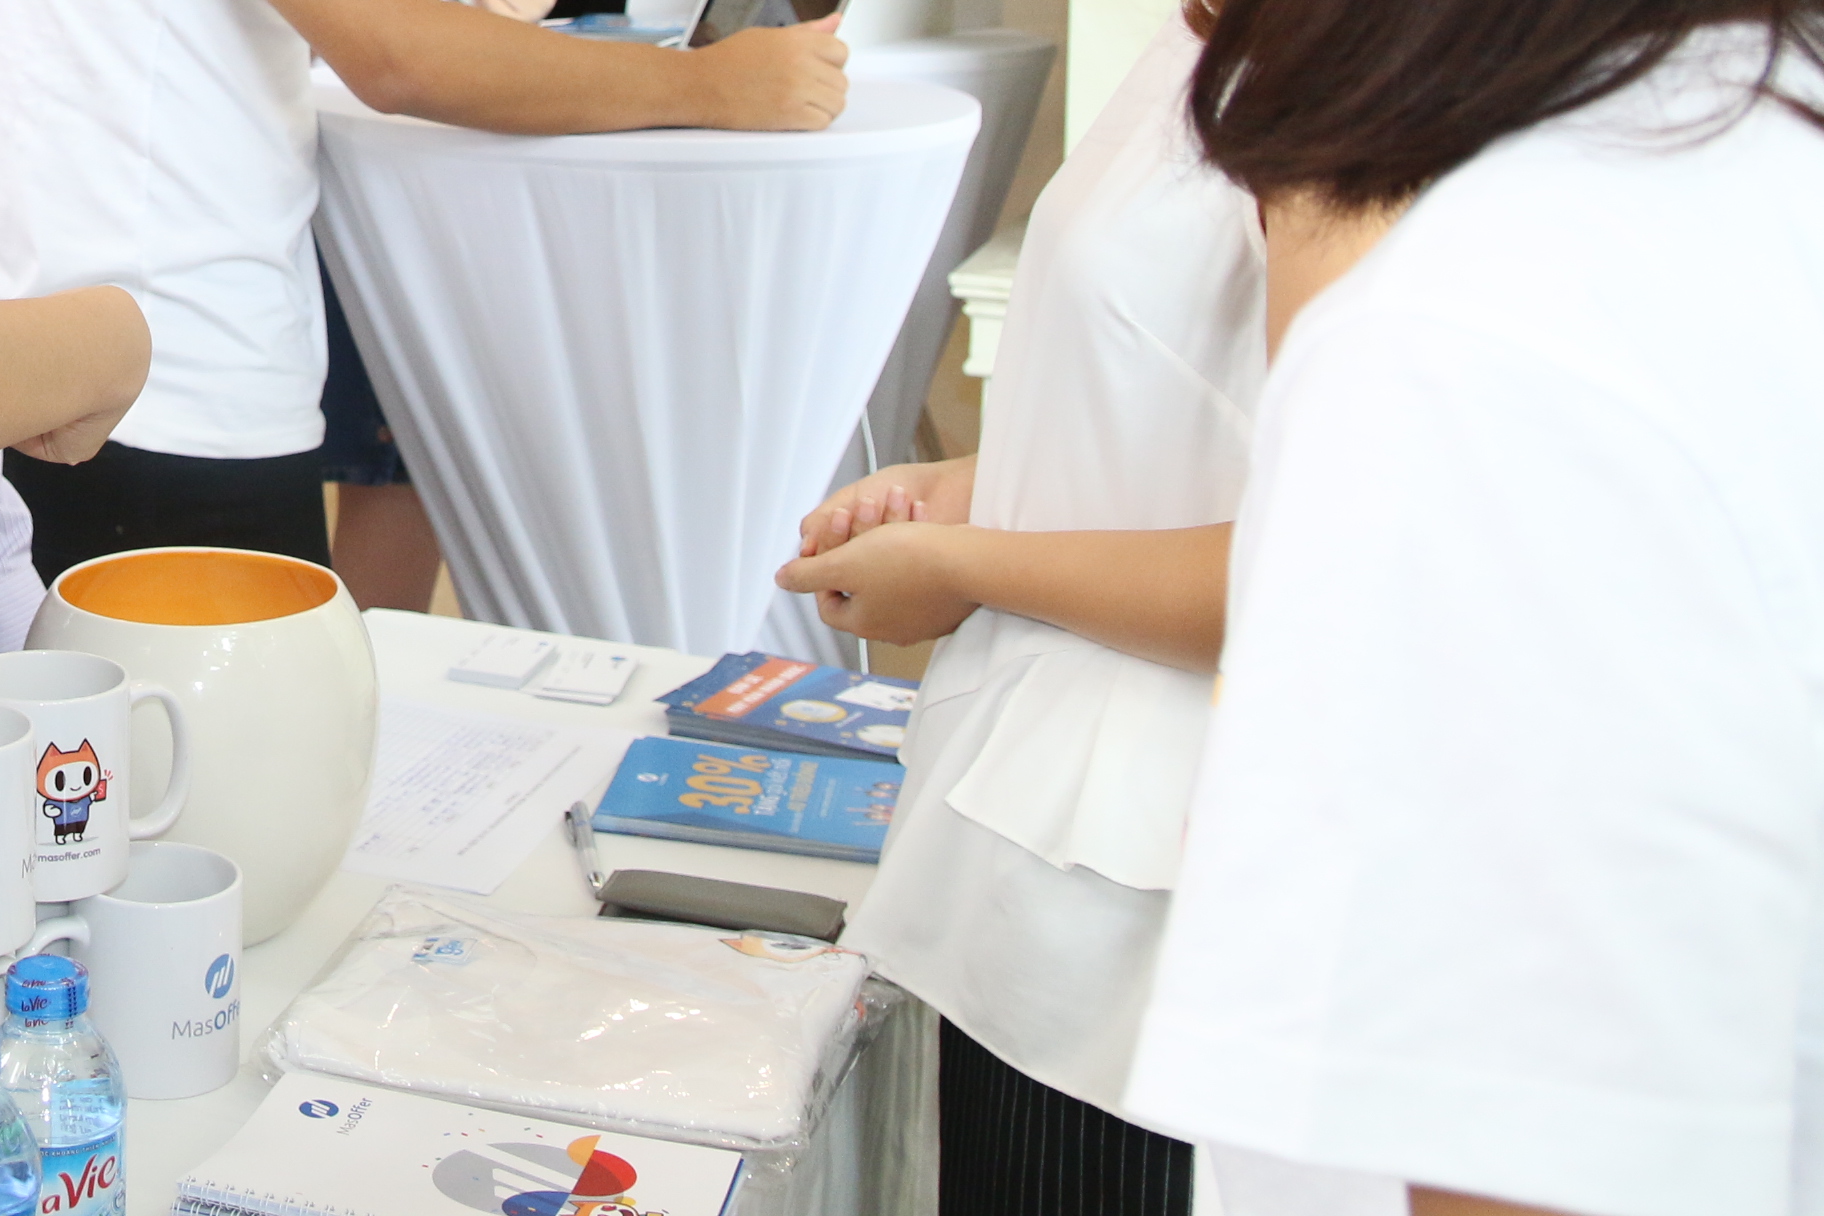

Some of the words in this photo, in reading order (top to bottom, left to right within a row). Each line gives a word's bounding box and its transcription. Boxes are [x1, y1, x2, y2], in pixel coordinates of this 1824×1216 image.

[678, 754, 771, 815] 30%
[37, 848, 101, 863] masoffer.com
[336, 1097, 373, 1136] MasOffer
[42, 1154, 117, 1214] aVie
